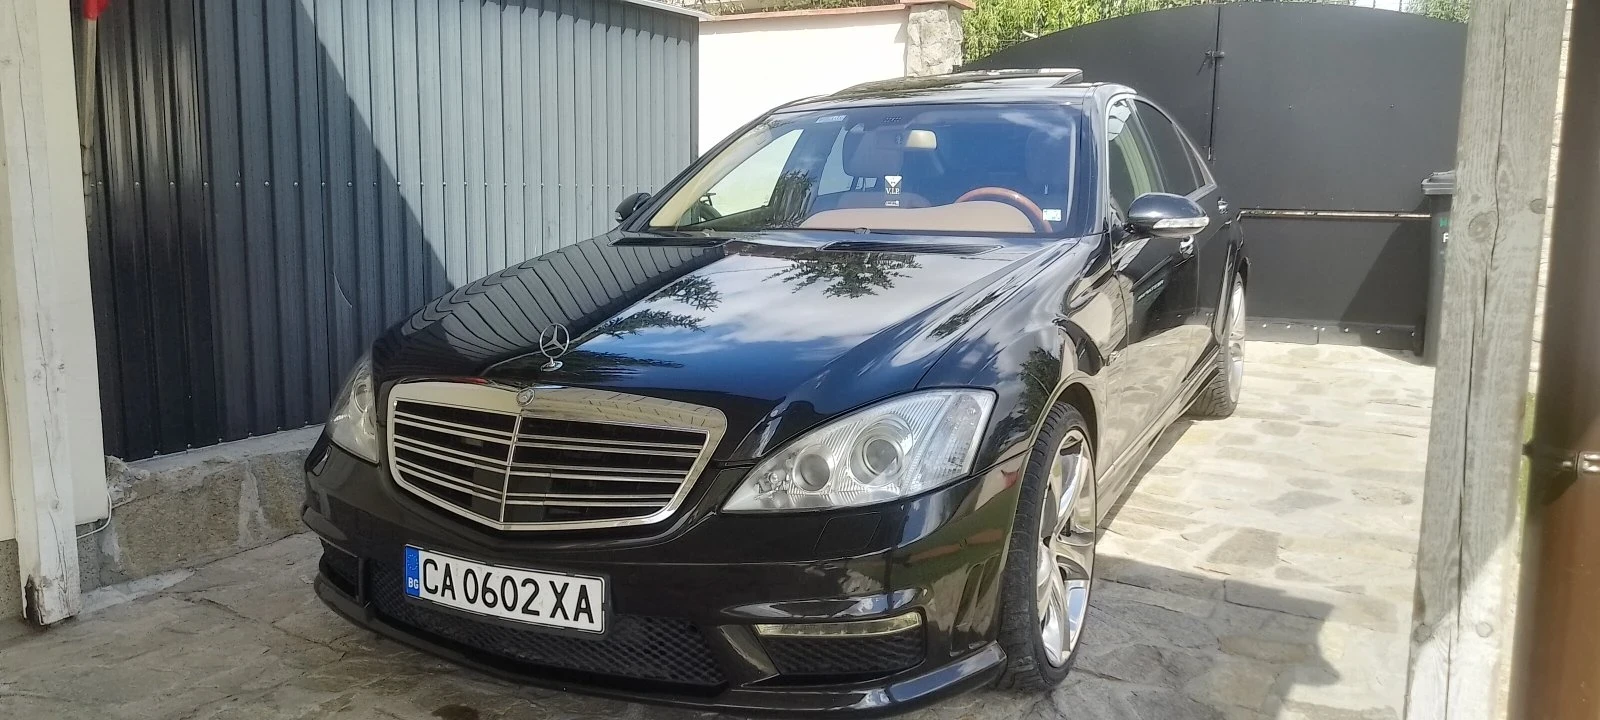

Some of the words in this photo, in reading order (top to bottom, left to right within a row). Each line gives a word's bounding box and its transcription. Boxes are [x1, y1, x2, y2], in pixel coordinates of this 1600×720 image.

[408, 576, 419, 590] BG
[422, 558, 457, 601] CA
[463, 568, 541, 617] 0602
[549, 580, 595, 624] XA
